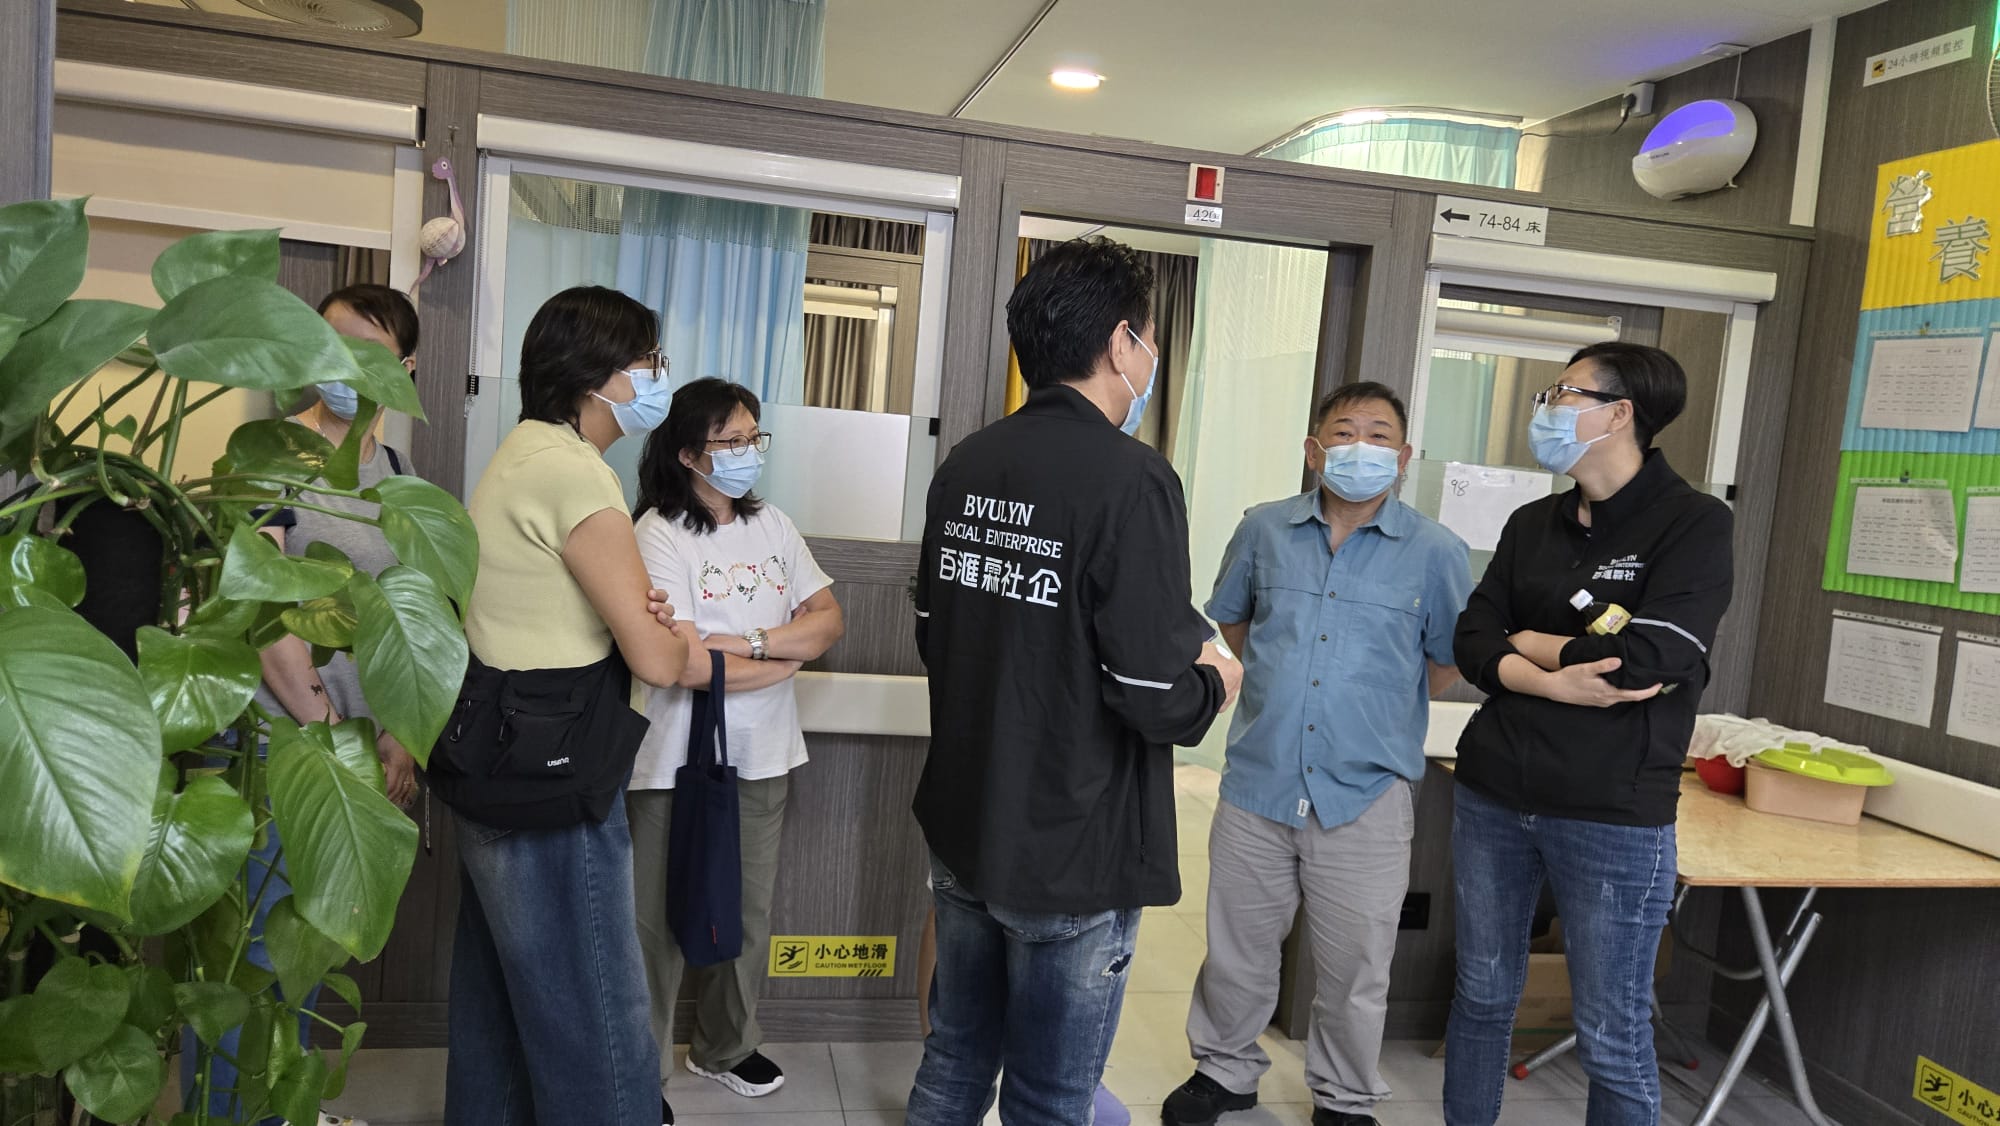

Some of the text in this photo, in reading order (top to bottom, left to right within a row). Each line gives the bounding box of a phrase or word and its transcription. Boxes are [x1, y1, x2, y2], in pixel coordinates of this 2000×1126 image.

[1479, 212, 1541, 234] 74-84 床
[1450, 479, 1470, 497] 98
[963, 494, 1035, 527] BVULYN
[944, 520, 1063, 559] SOCIAL ENTERPRISE
[814, 943, 888, 960] 小心地滑
[1958, 1089, 2000, 1121] 小心
